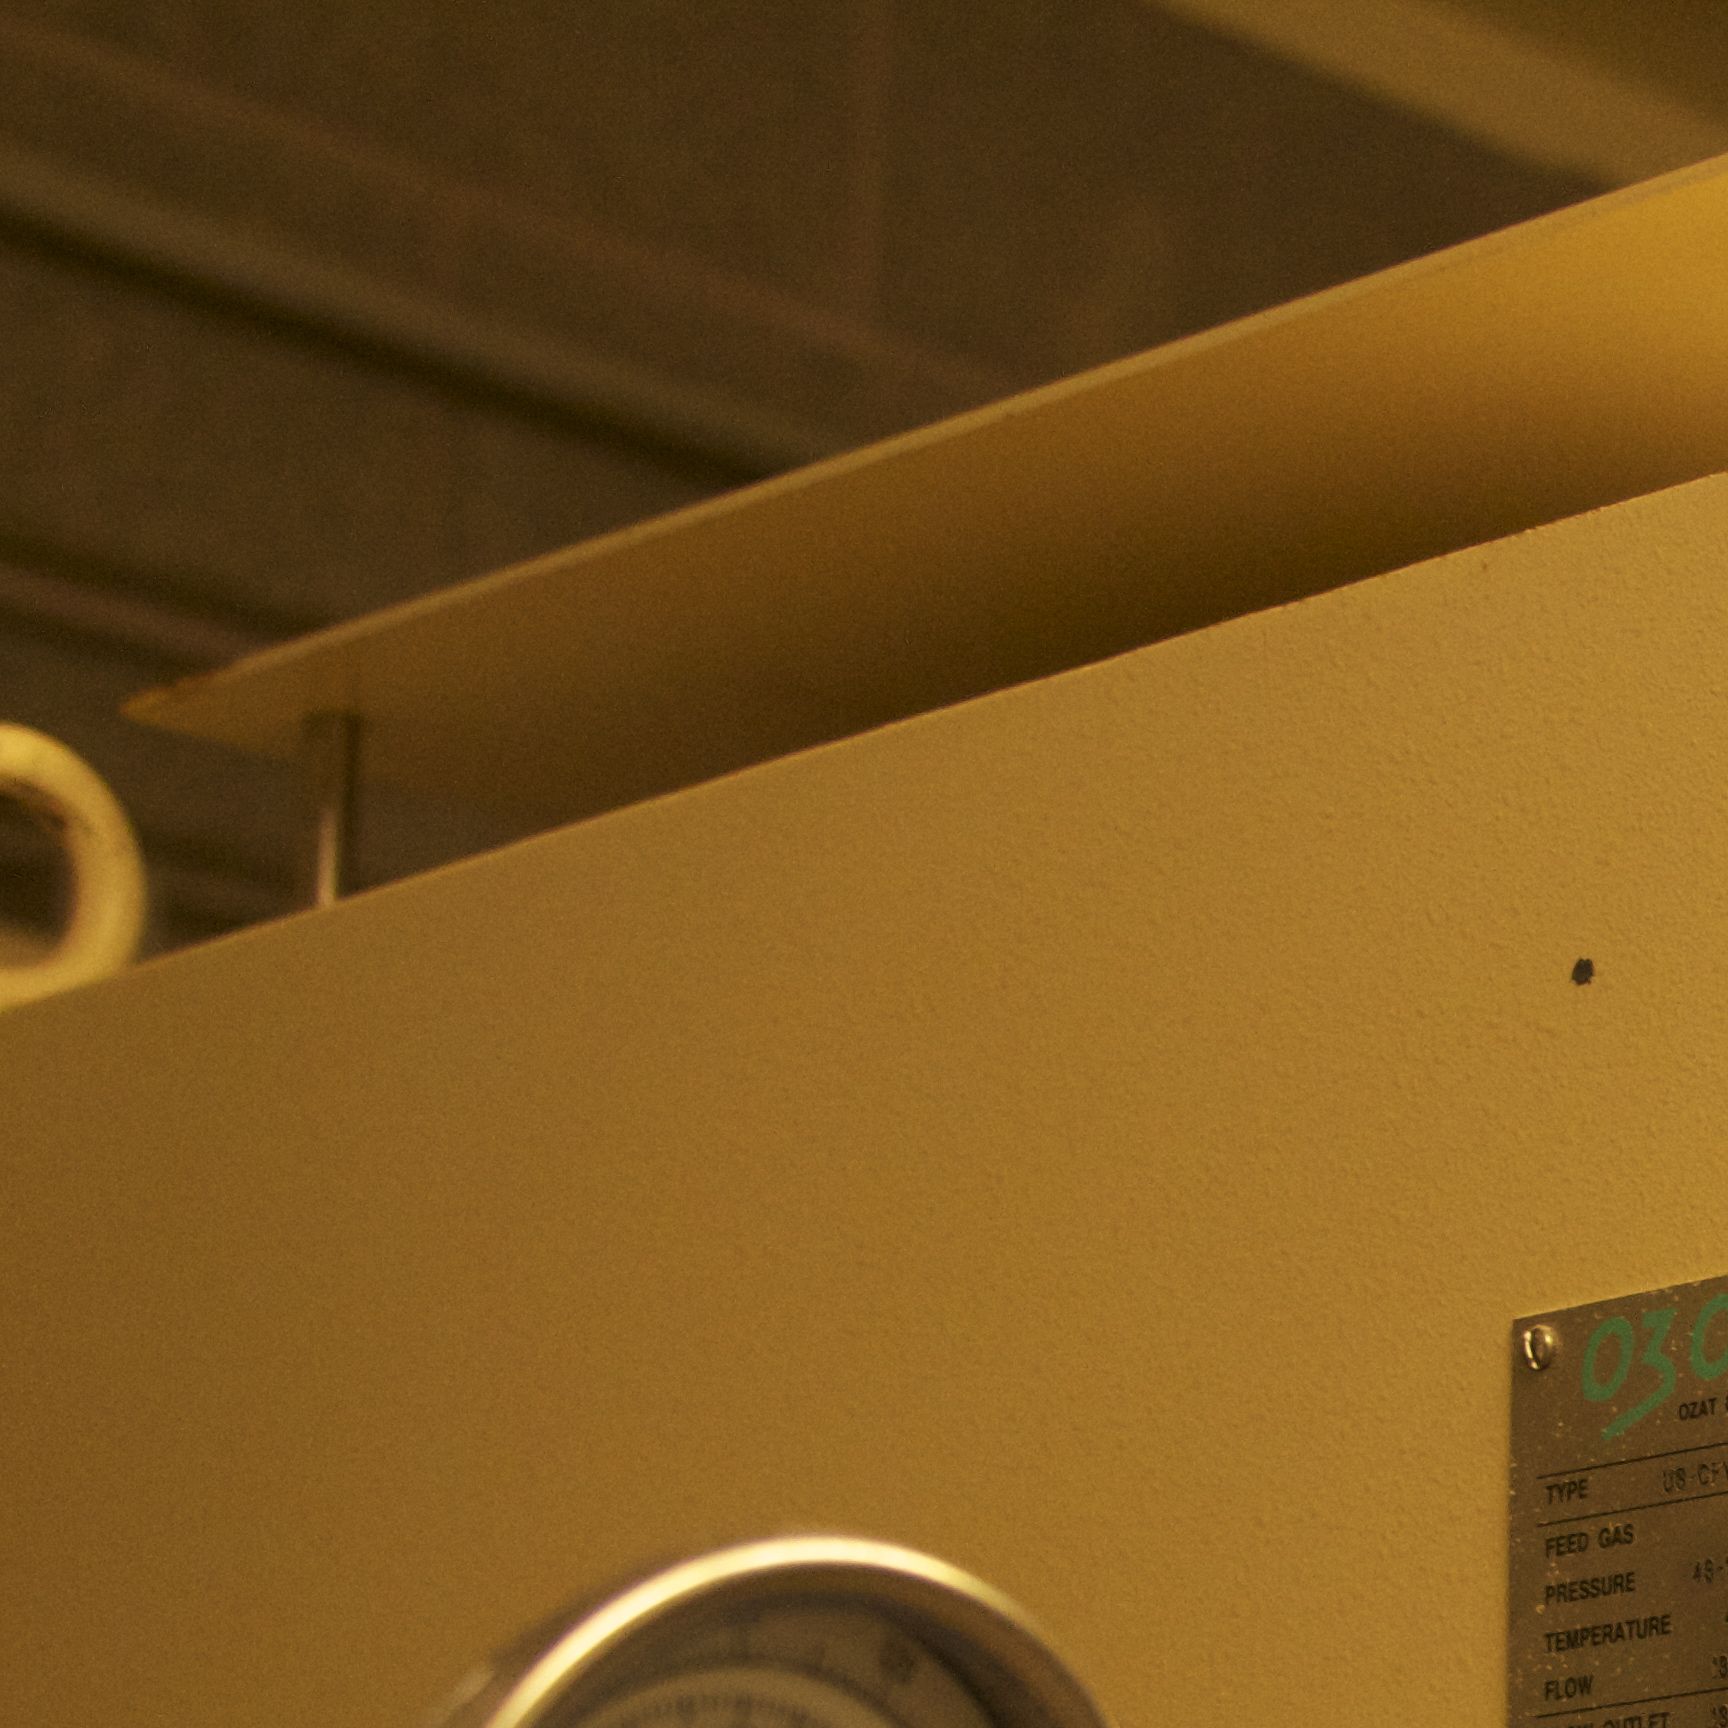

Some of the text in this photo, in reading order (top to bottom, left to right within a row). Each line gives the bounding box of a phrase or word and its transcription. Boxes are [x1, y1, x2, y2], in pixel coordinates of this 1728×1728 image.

[1678, 1397, 1716, 1421] OZAT
[1545, 1478, 1588, 1505] TYPE
[1545, 1532, 1589, 1558] FEED
[1598, 1523, 1635, 1549] GAS
[1545, 1571, 1636, 1605] PRESSURE
[1543, 1614, 1673, 1652] TEMPERATURE
[1544, 1674, 1595, 1701] FLOW
